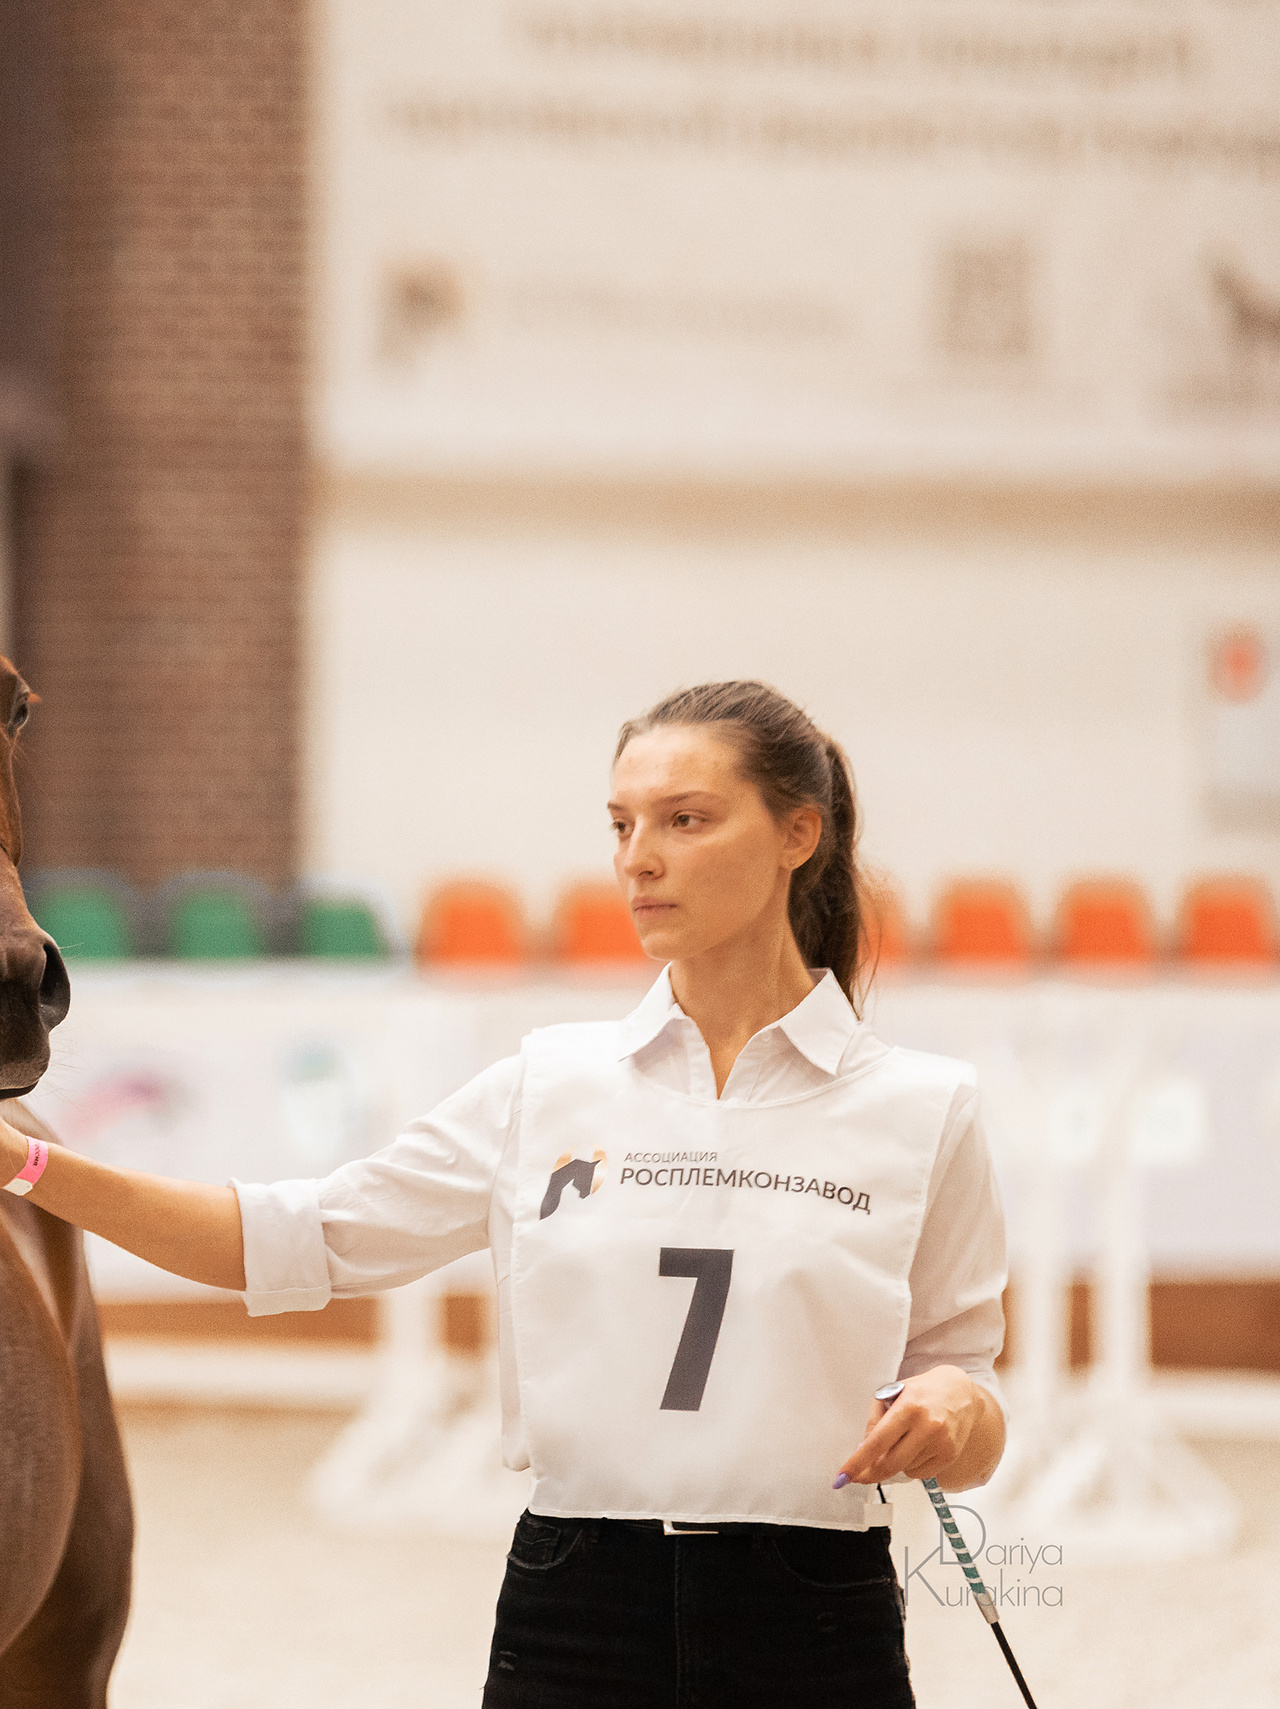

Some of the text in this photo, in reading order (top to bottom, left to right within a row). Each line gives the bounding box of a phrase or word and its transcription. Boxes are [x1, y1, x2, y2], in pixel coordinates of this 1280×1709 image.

[624, 1151, 718, 1163] АССОЦИАЦИЯ
[620, 1167, 872, 1215] РОСПЛЕМКОНЗАВОД
[659, 1247, 734, 1411] 7
